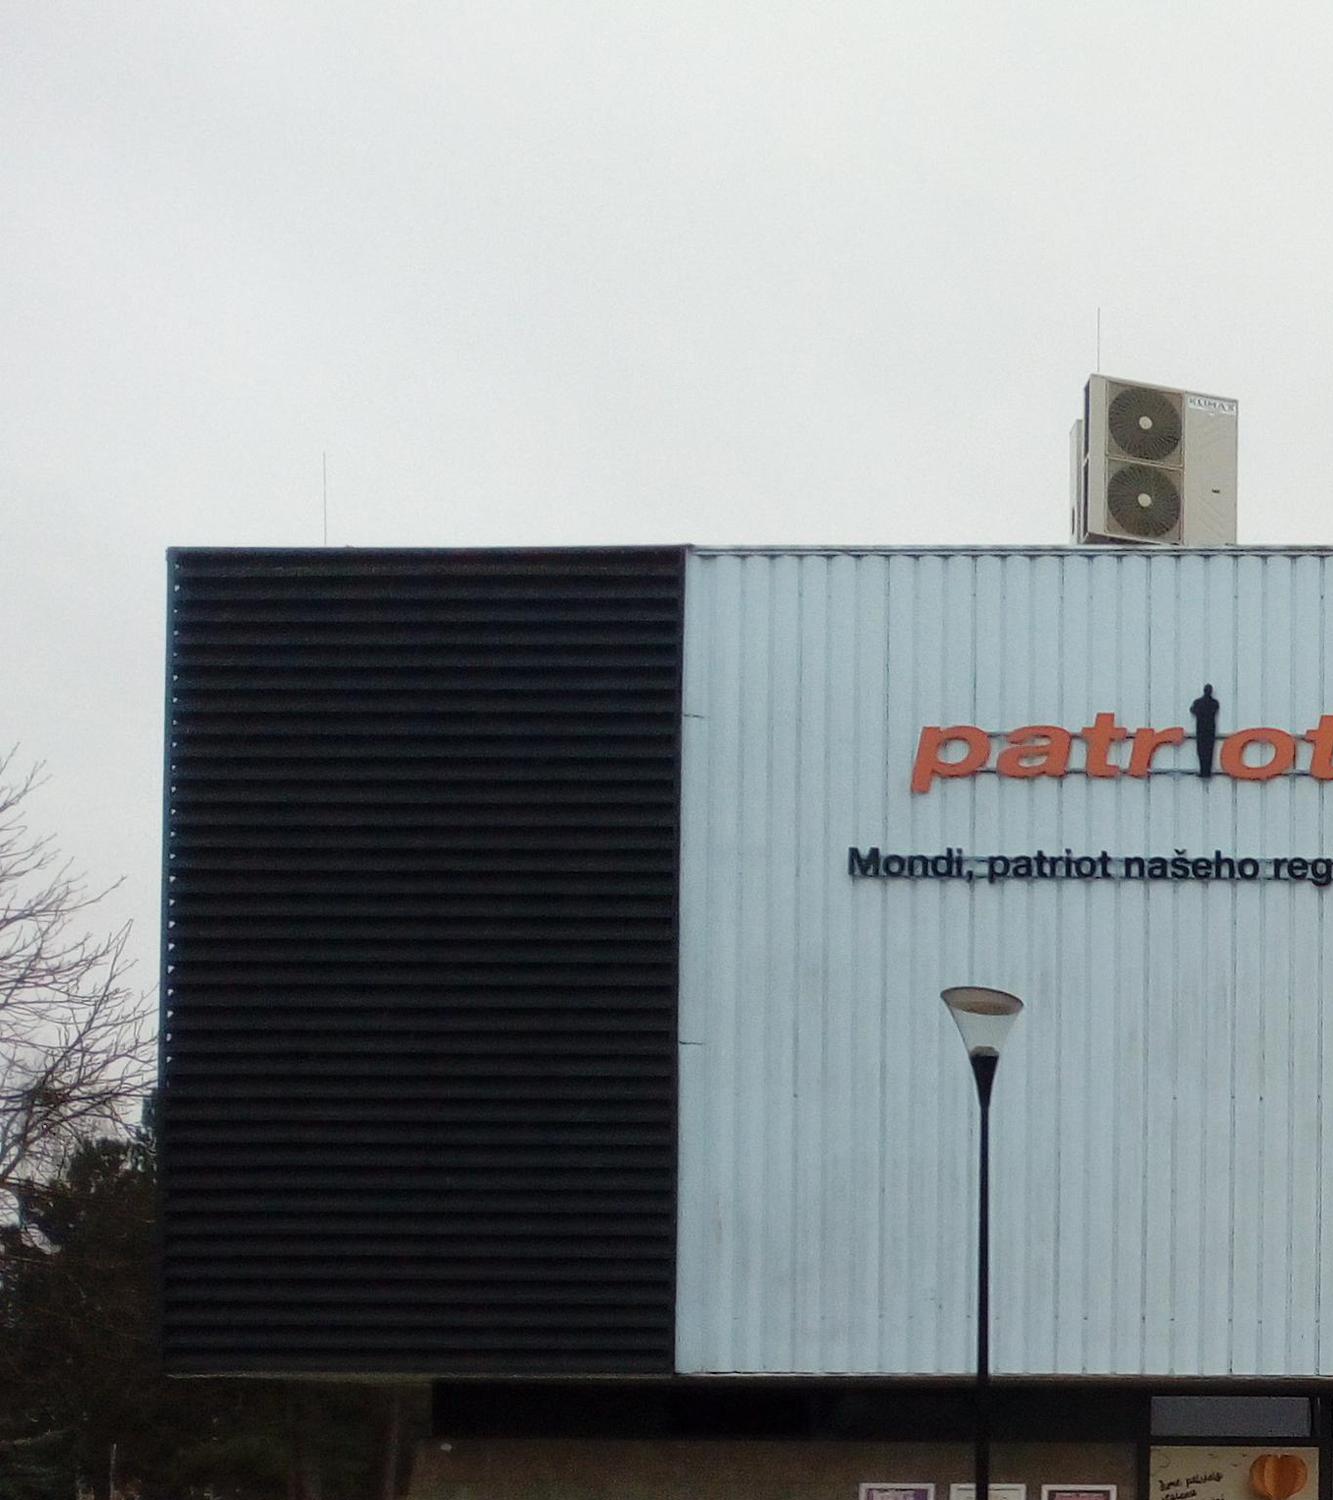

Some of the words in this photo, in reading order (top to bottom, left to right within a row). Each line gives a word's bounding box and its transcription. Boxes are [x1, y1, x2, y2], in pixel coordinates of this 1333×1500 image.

[848, 847, 973, 884] Mondi,
[988, 848, 1112, 884] patriot
[1124, 849, 1259, 880] našeho
